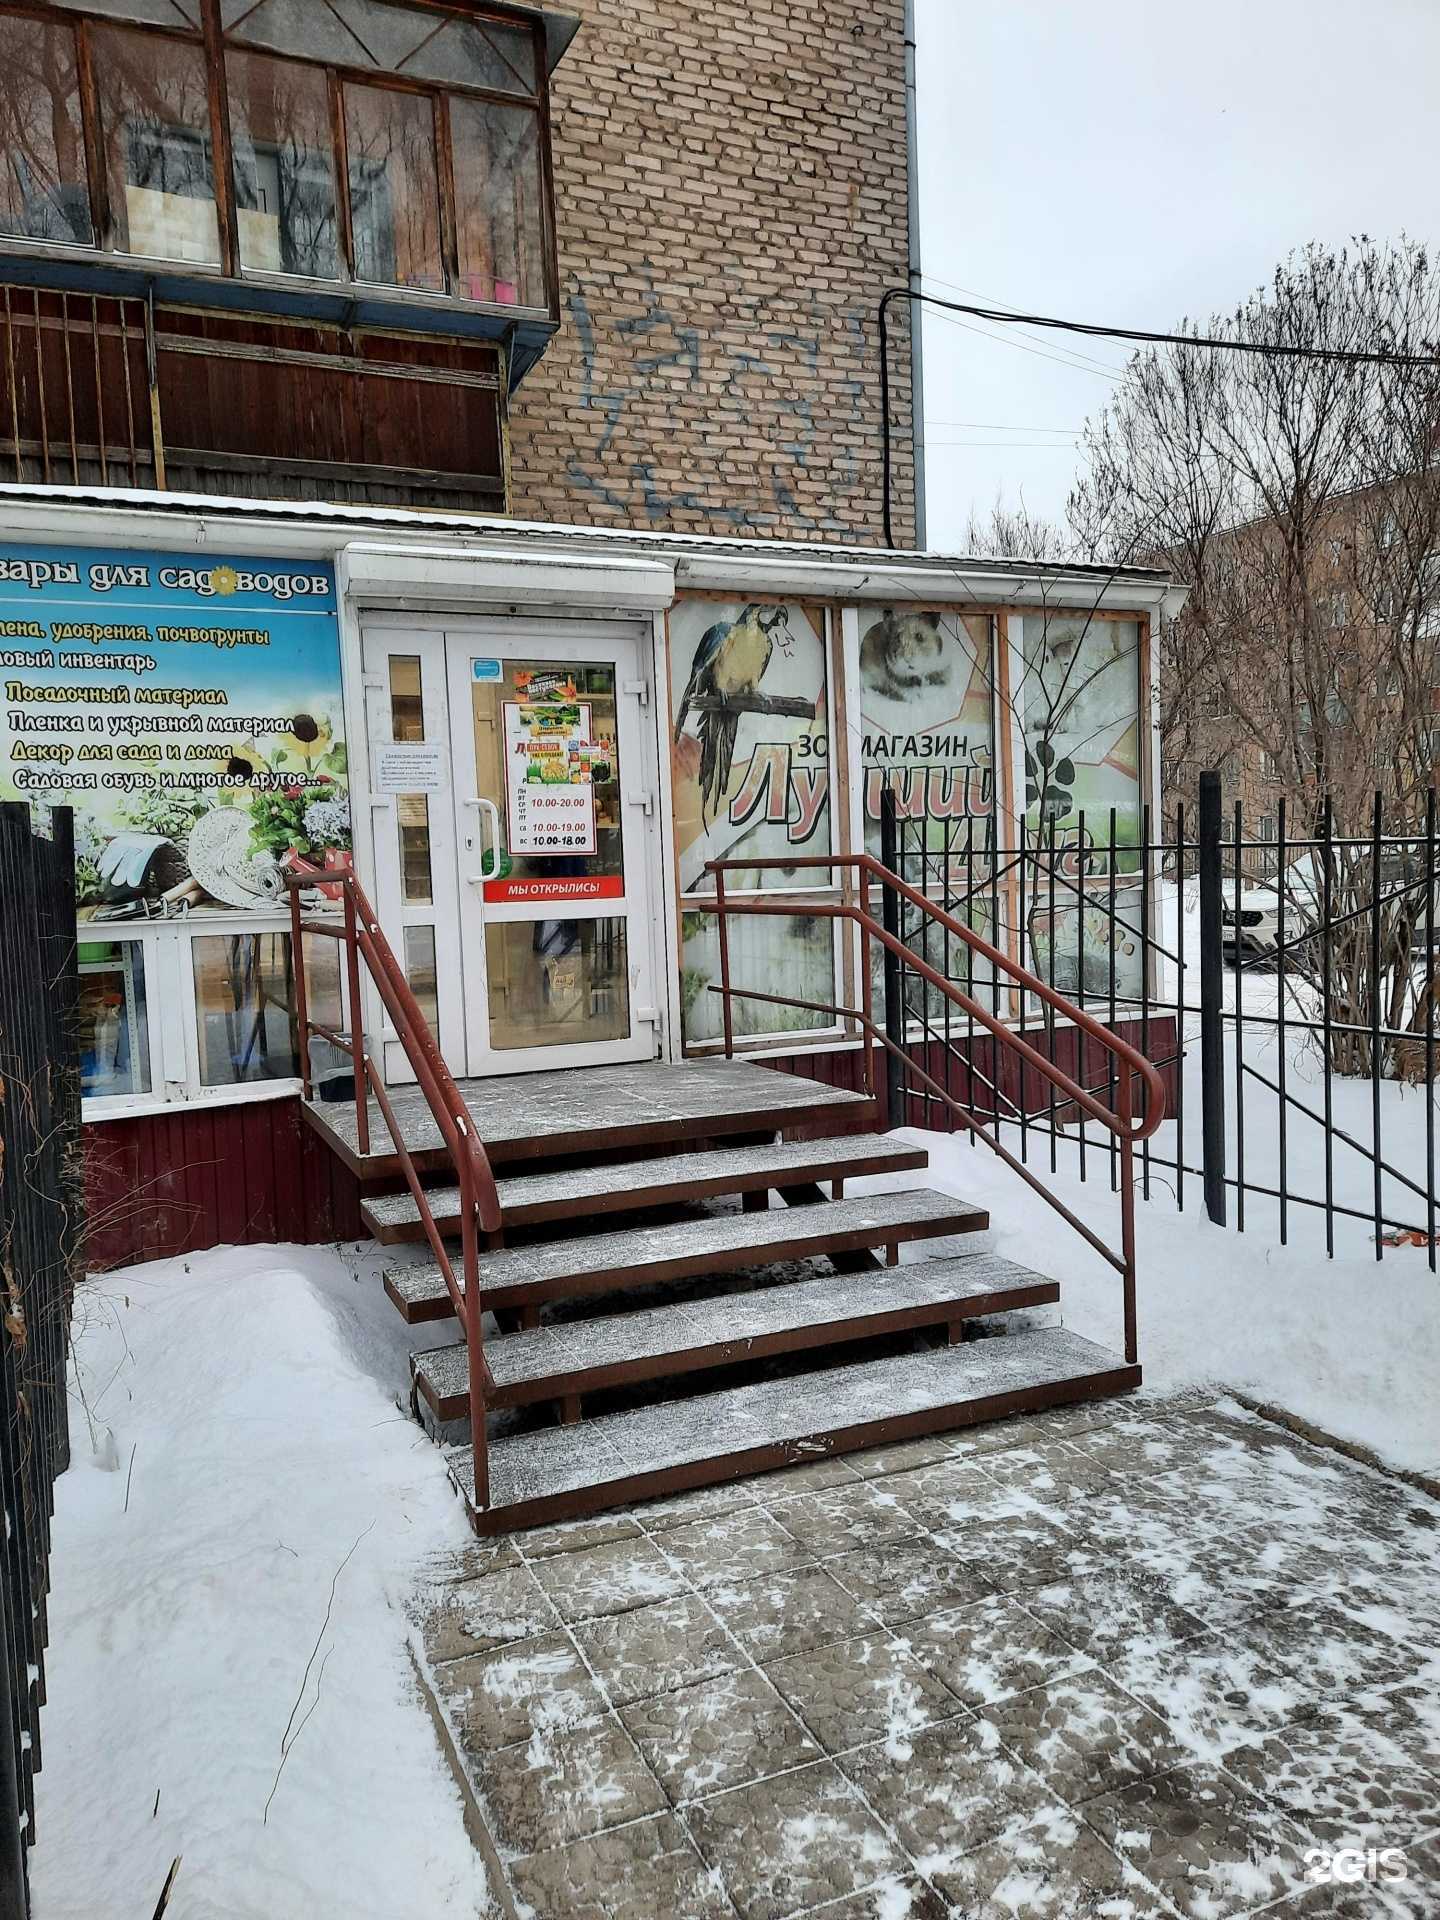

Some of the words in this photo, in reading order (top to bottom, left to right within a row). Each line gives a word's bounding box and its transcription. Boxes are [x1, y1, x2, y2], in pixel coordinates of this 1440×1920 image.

[89, 564, 150, 591] для
[159, 568, 330, 600] садводов
[156, 626, 270, 648] почвогрунты
[59, 652, 156, 675] инвентарь
[5, 681, 130, 703] Посадочный
[135, 688, 228, 709] материал
[8, 711, 84, 732] Пленка
[89, 717, 103, 732] и
[107, 715, 202, 737] укрывной
[207, 717, 296, 737] материал
[11, 740, 73, 765] Декор
[78, 745, 113, 760] для
[117, 745, 162, 760] сада
[166, 745, 180, 760] и
[185, 745, 234, 760] дома
[13, 769, 98, 789] Садовая
[102, 773, 156, 792] обувь
[160, 773, 175, 788] и
[179, 773, 246, 788] многое
[249, 772, 322, 792] другое...
[532, 798, 585, 808] 10.00-20.00
[533, 823, 586, 832] 10.00-19.00
[533, 836, 587, 846] 10.00-18.00
[508, 885, 528, 895] МЫ
[530, 882, 600, 894] ОТКРЫЛИСЬ!
